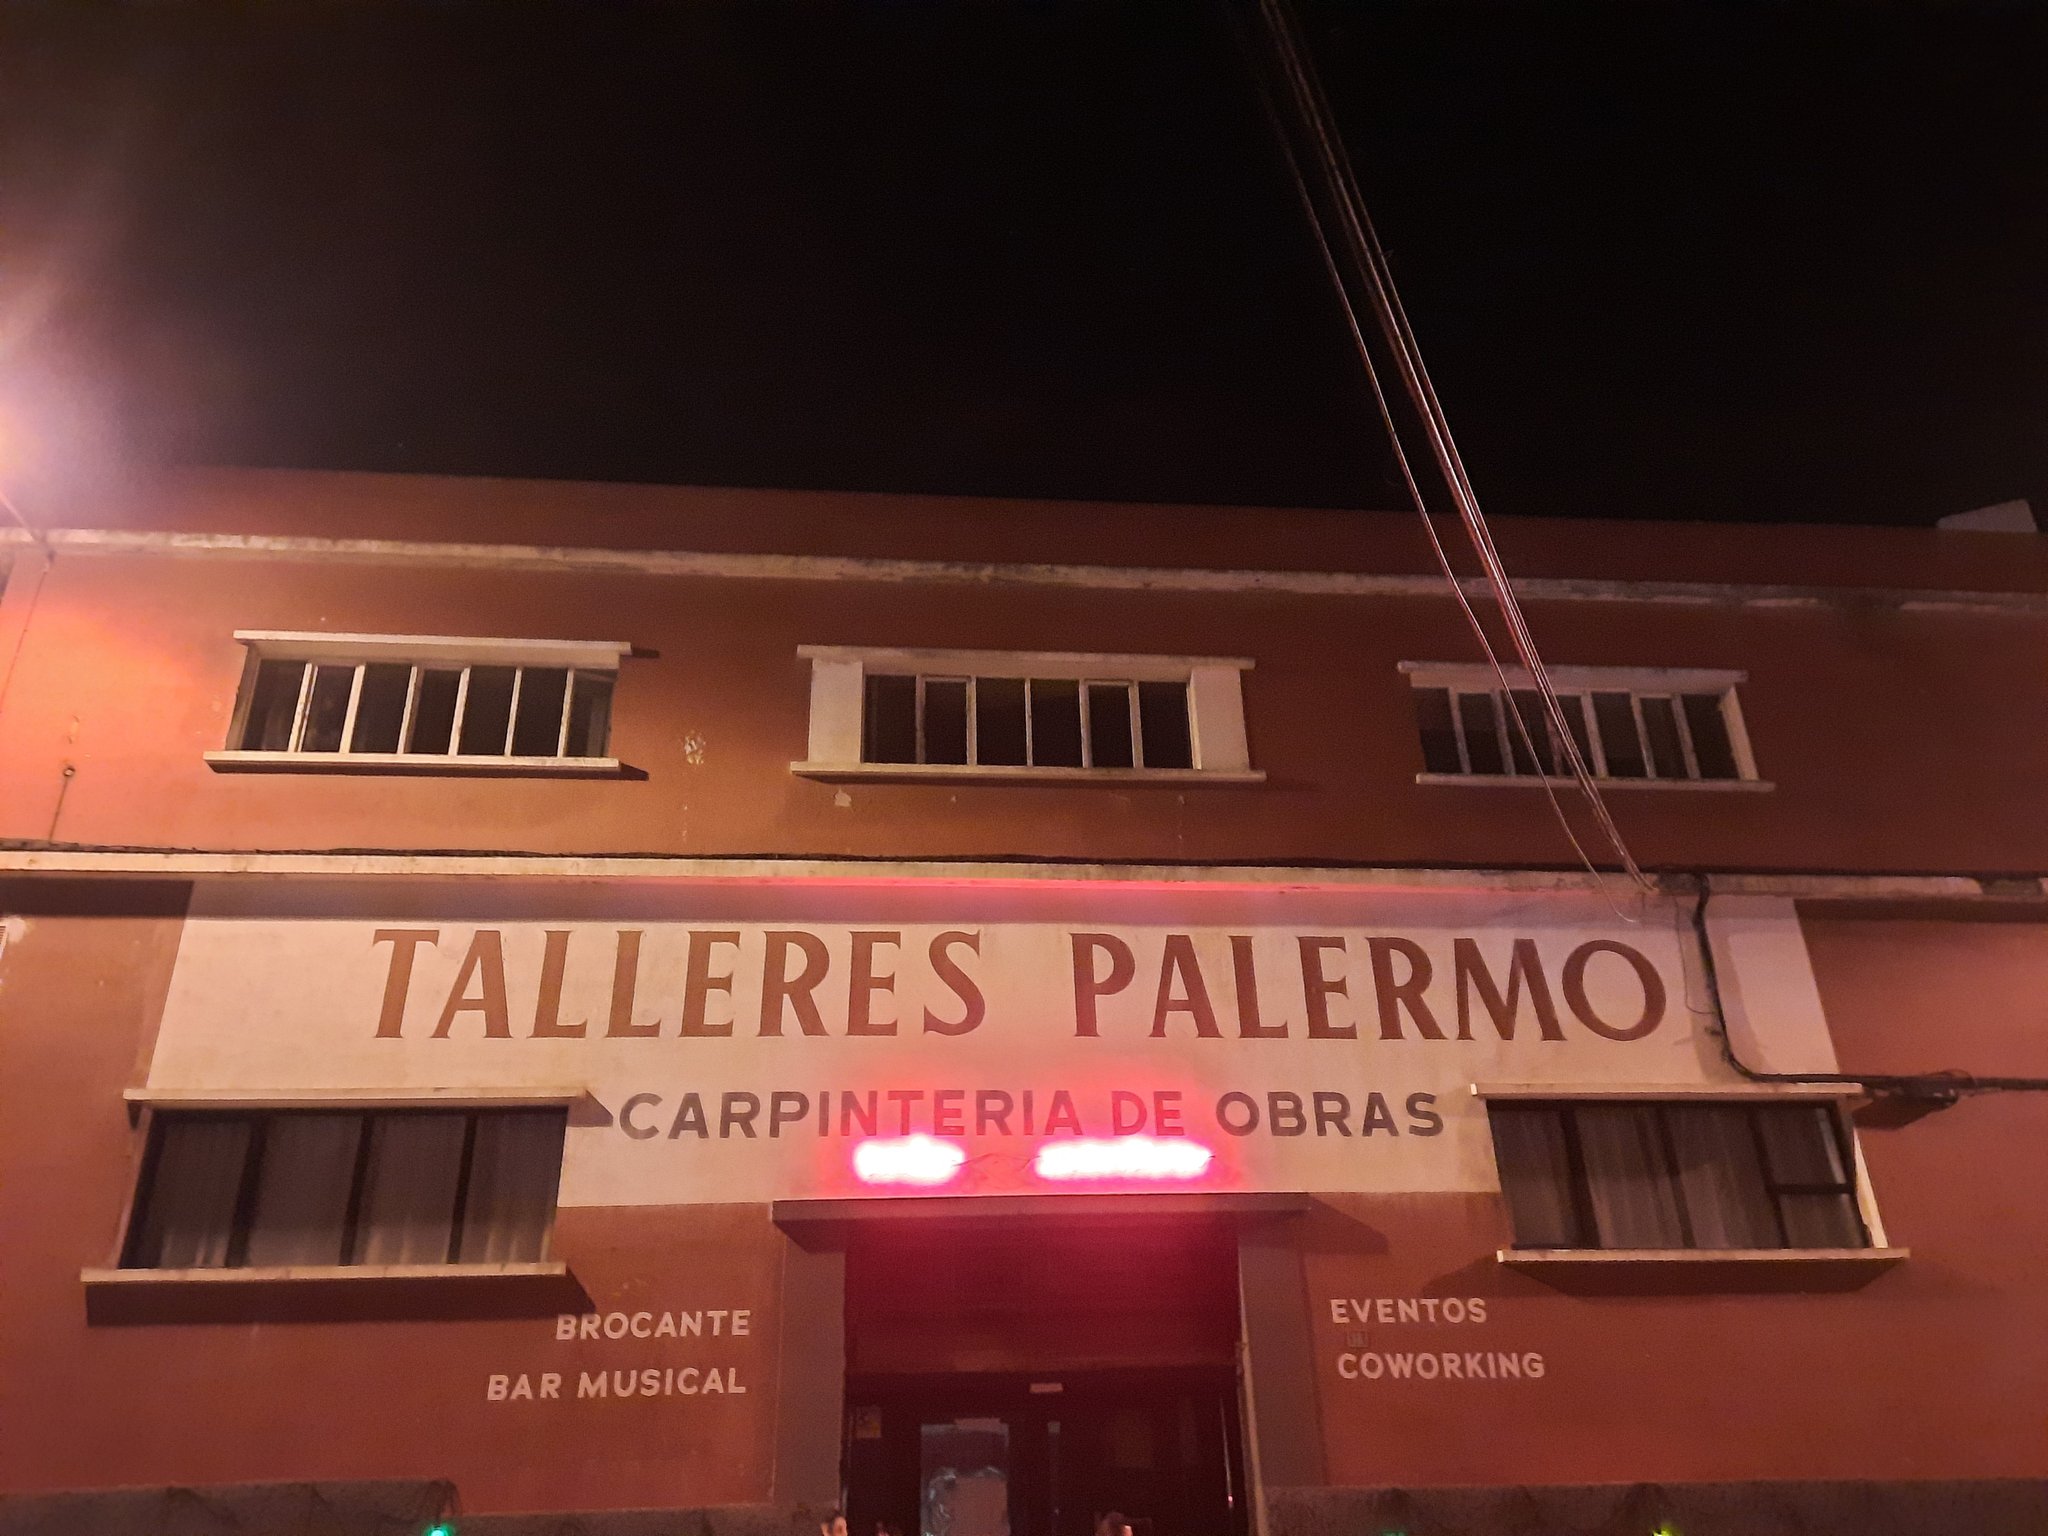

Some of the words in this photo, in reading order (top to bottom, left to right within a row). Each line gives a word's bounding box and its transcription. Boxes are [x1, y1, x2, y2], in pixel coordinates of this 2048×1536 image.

[372, 928, 987, 1040] TALLERES
[1067, 932, 1667, 1042] PALERMO
[618, 1088, 1084, 1141] CARPINTERIA
[1110, 1089, 1186, 1137] DE
[1214, 1090, 1444, 1138] OBRAS
[555, 1309, 751, 1341] BROCANTE
[1329, 1297, 1488, 1325] EVENTOS
[1337, 1351, 1546, 1380] COWORKING
[486, 1372, 562, 1401] BAR
[576, 1366, 747, 1399] MUSICAL
